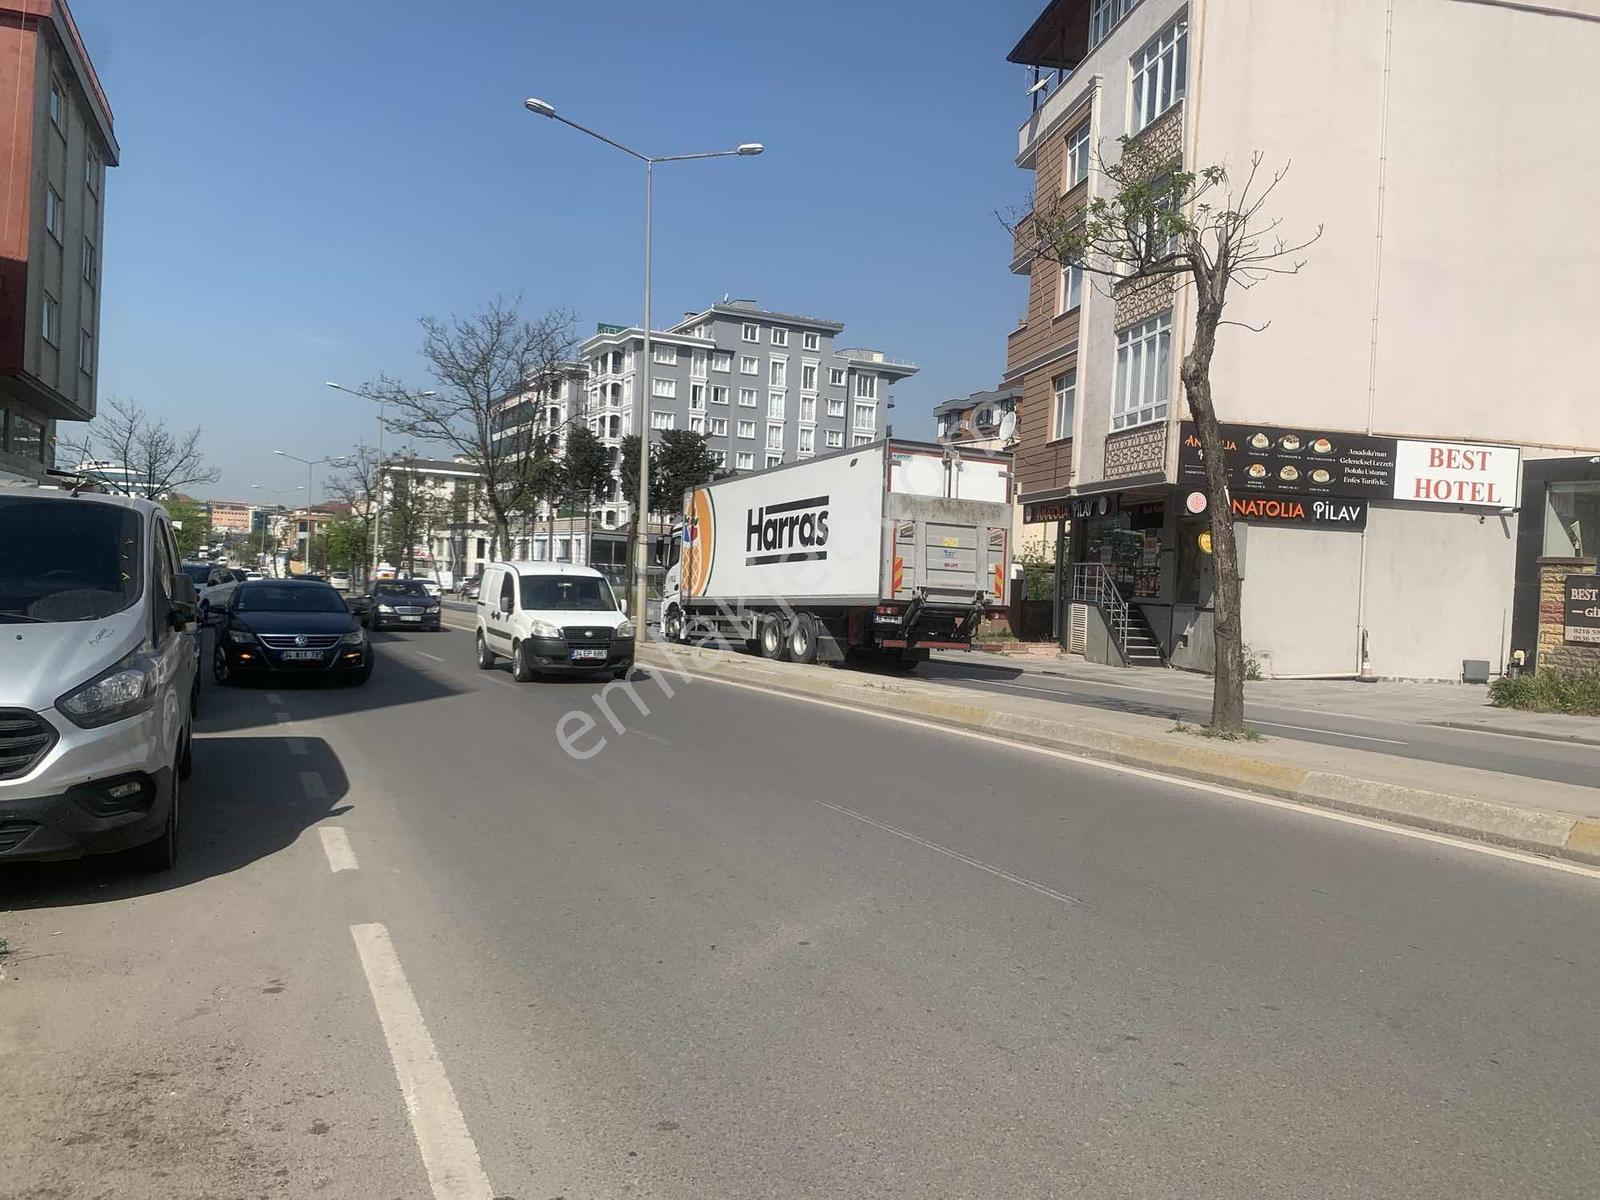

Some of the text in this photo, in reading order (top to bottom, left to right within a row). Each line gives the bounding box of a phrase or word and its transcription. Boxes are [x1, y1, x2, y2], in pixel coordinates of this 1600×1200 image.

[1428, 447, 1492, 471] BEST
[1413, 477, 1502, 503] HOTEL
[1232, 499, 1361, 521] NATOLIA PİLAV
[745, 506, 830, 552] Harras
[1570, 588, 1599, 601] BEST
